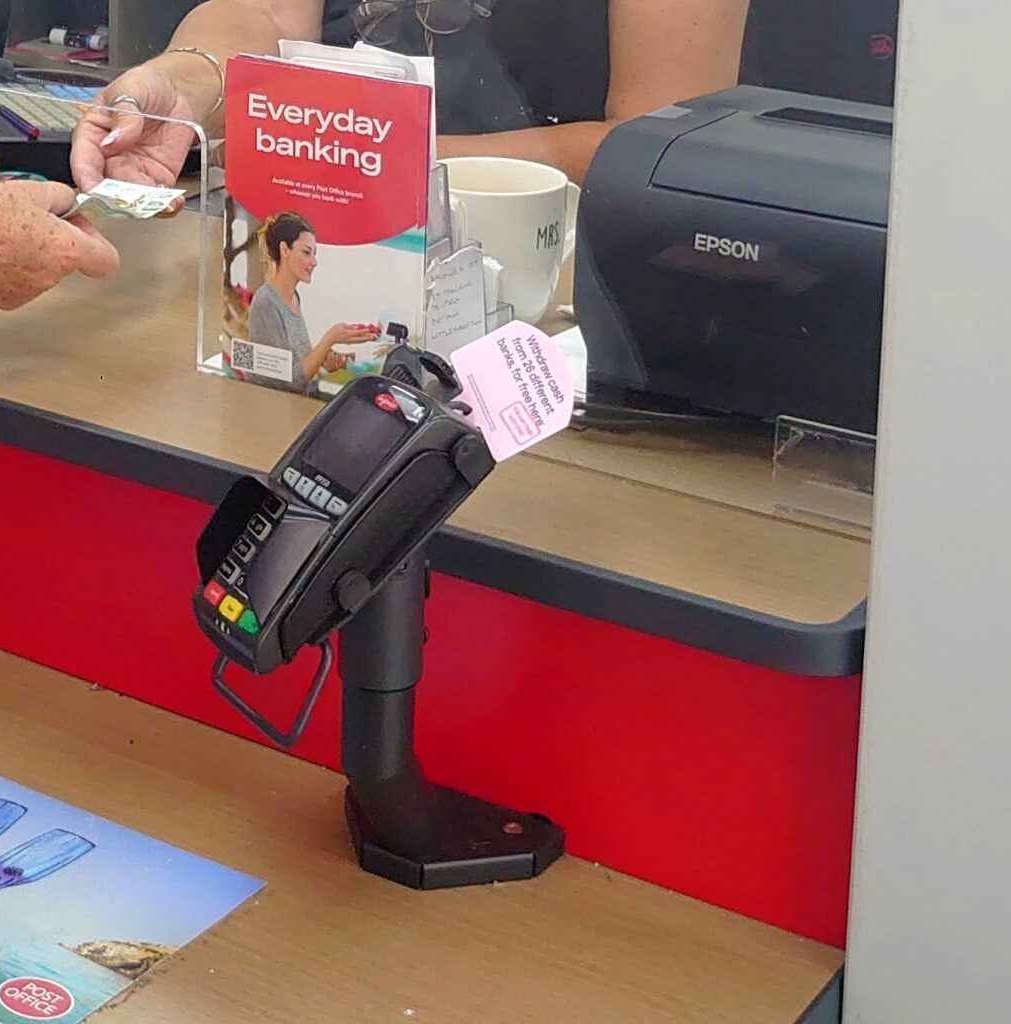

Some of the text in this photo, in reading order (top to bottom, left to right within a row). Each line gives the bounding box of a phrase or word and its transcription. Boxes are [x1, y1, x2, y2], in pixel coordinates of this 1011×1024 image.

[248, 93, 393, 143] Everyday
[256, 127, 382, 177] banking
[271, 176, 295, 187] Available
[316, 184, 328, 193] Post
[328, 186, 345, 196] Office
[694, 233, 759, 262] EPSON
[497, 337, 516, 370] banks,
[511, 367, 524, 384] for
[518, 380, 533, 404] free
[512, 337, 555, 415] from 26 different
[526, 334, 565, 404] Withdraw cash
[4, 987, 58, 1015] OFFICE
[21, 982, 65, 1004] POST
